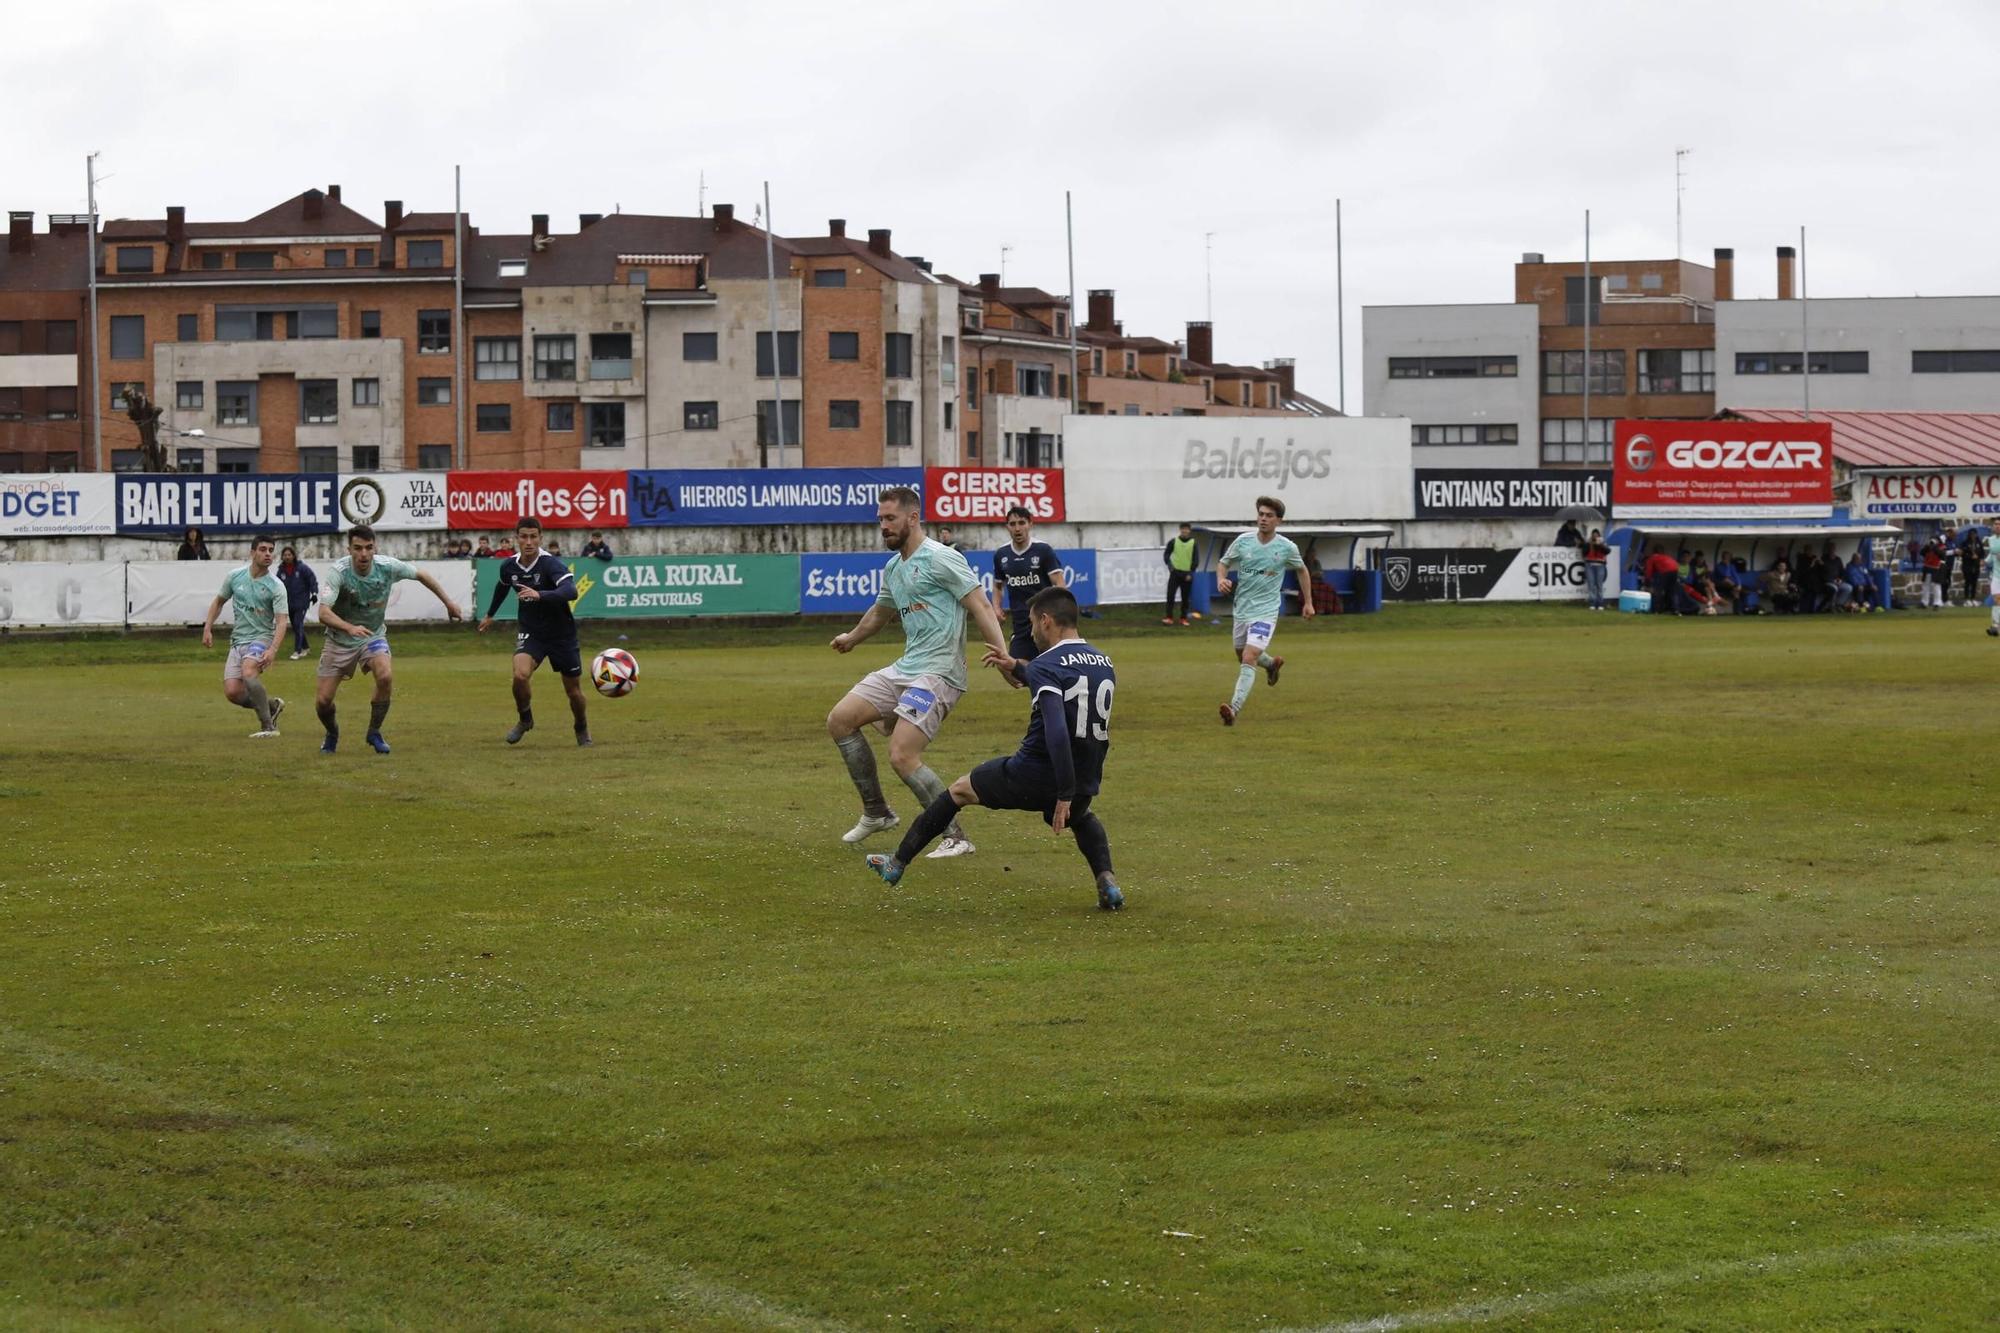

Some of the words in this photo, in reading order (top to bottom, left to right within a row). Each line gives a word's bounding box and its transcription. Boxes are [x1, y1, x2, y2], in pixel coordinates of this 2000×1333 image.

[1182, 437, 1332, 490] Baldajos
[1666, 440, 1823, 469] GOZCAR
[410, 481, 435, 493] VIA
[941, 472, 1047, 495] CIERRES
[1420, 480, 1504, 508] VENTANAS
[1508, 476, 1608, 508] CASTRILLÓN
[1867, 474, 1958, 499] ACESOL
[3, 491, 80, 518] DGET
[123, 481, 180, 525] BAR
[185, 482, 219, 525] EL
[223, 481, 333, 524] MUELLE
[400, 495, 445, 508] APPIA
[450, 490, 513, 512] COLCHON
[680, 485, 747, 508] HIERROS
[751, 484, 842, 507] LAMINADOS
[411, 509, 434, 517] CAFE
[603, 565, 660, 588] CAJA
[665, 563, 743, 586] RURAL
[1417, 565, 1487, 574] PEUGEOT
[606, 594, 626, 607] DE
[629, 592, 703, 606] ASTURIAS
[1063, 675, 1115, 741] 19
